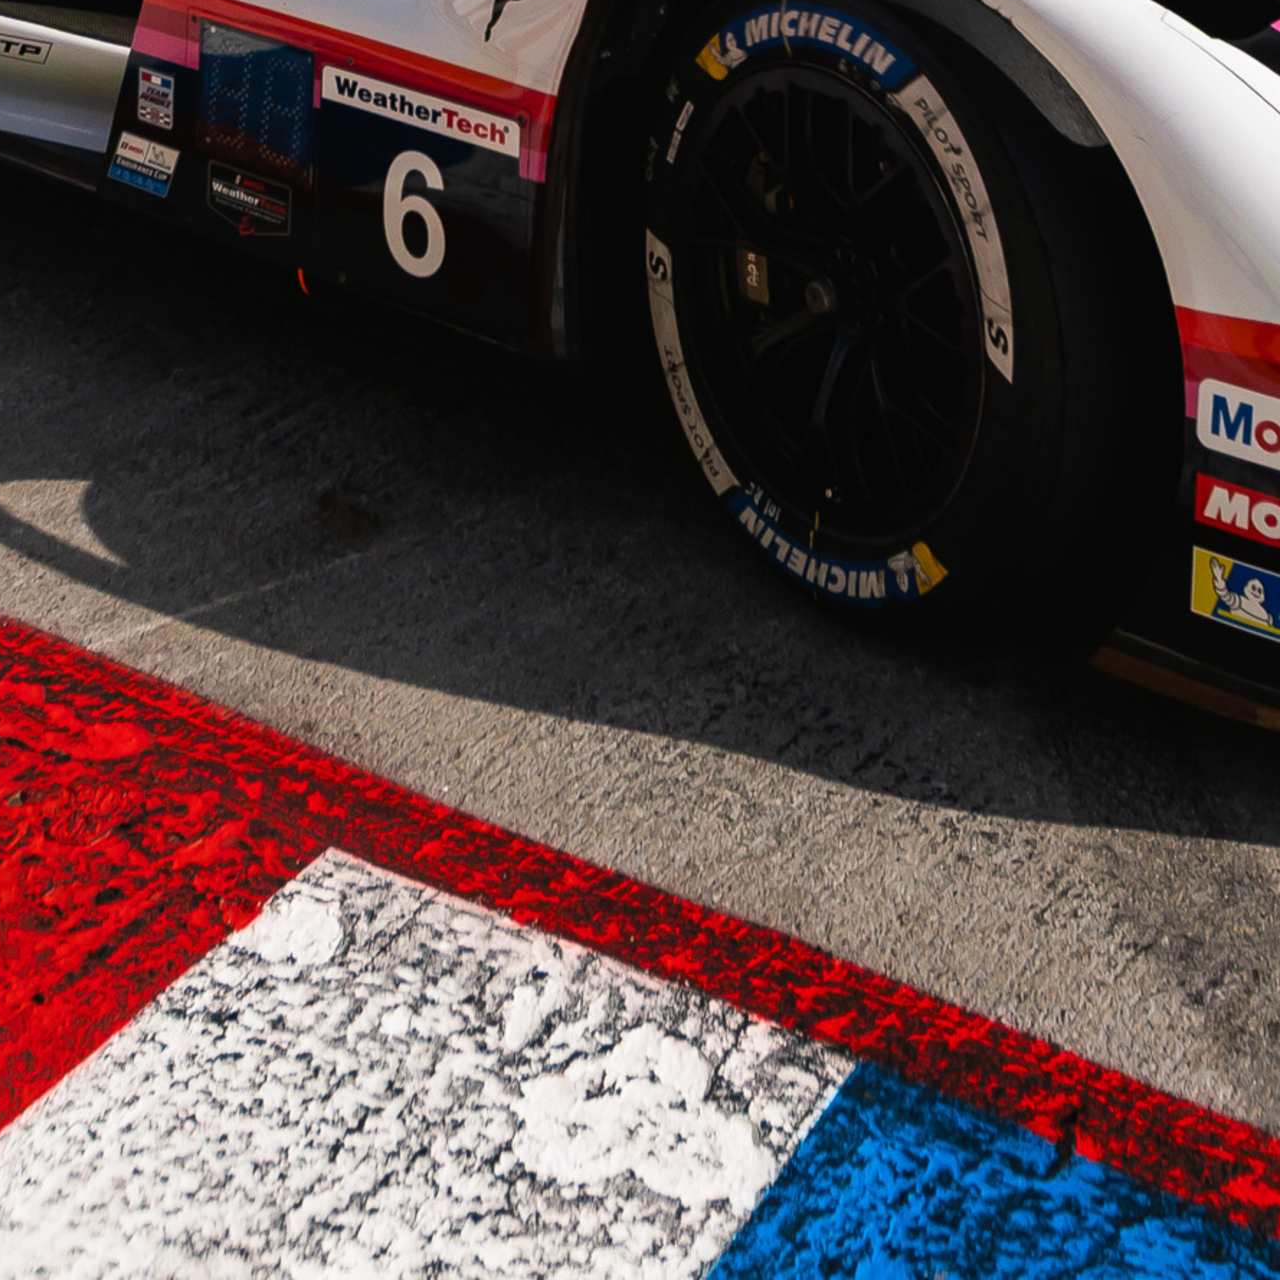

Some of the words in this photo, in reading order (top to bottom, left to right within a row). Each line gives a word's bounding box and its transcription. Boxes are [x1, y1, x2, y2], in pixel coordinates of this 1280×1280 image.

[744, 8, 896, 77] MICHELIN
[334, 75, 506, 146] WeatherTech
[913, 97, 964, 158] PILOT
[951, 161, 989, 243] SPORT
[382, 149, 447, 279] 6
[648, 248, 669, 283] S
[986, 316, 1009, 357] S
[737, 505, 887, 600] MICHELIN
